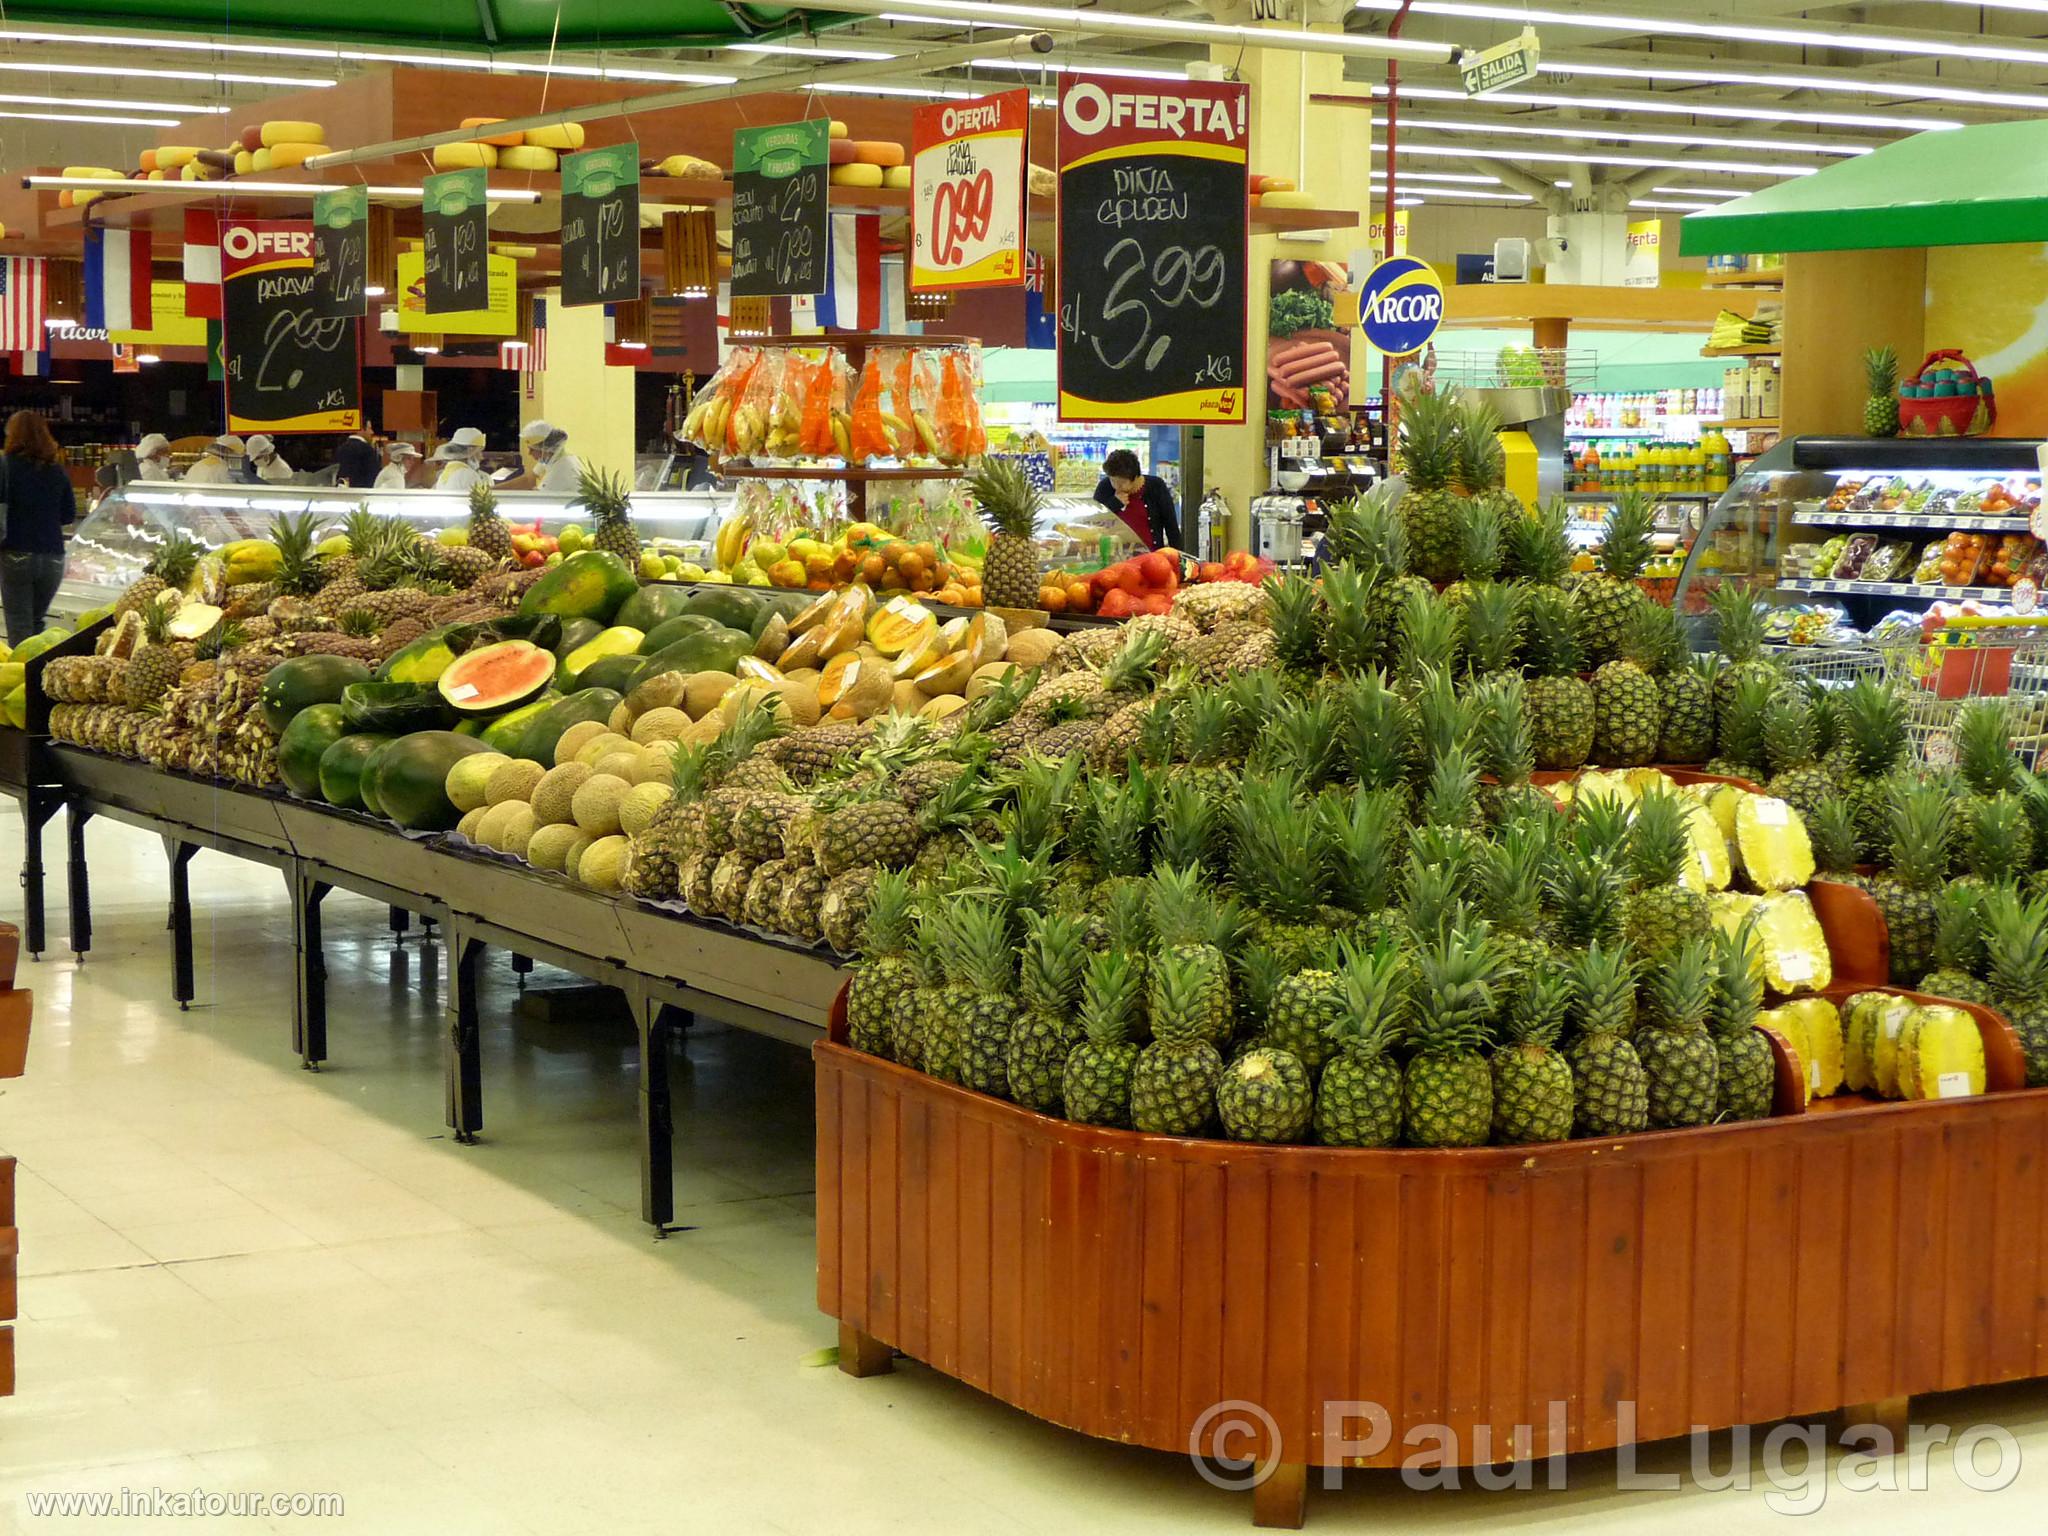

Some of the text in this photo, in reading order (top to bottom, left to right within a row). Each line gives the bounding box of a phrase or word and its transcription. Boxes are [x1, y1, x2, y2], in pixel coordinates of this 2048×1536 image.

[1481, 53, 1523, 80] SALIDA
[942, 100, 1001, 137] OFERTA!
[1063, 83, 1245, 141] OFERTA!
[931, 168, 994, 266] 0.99
[1097, 192, 1188, 229] GOLDEN
[224, 227, 314, 259] OFER
[1091, 238, 1226, 371] 3.99
[1361, 289, 1441, 324] ARCOR
